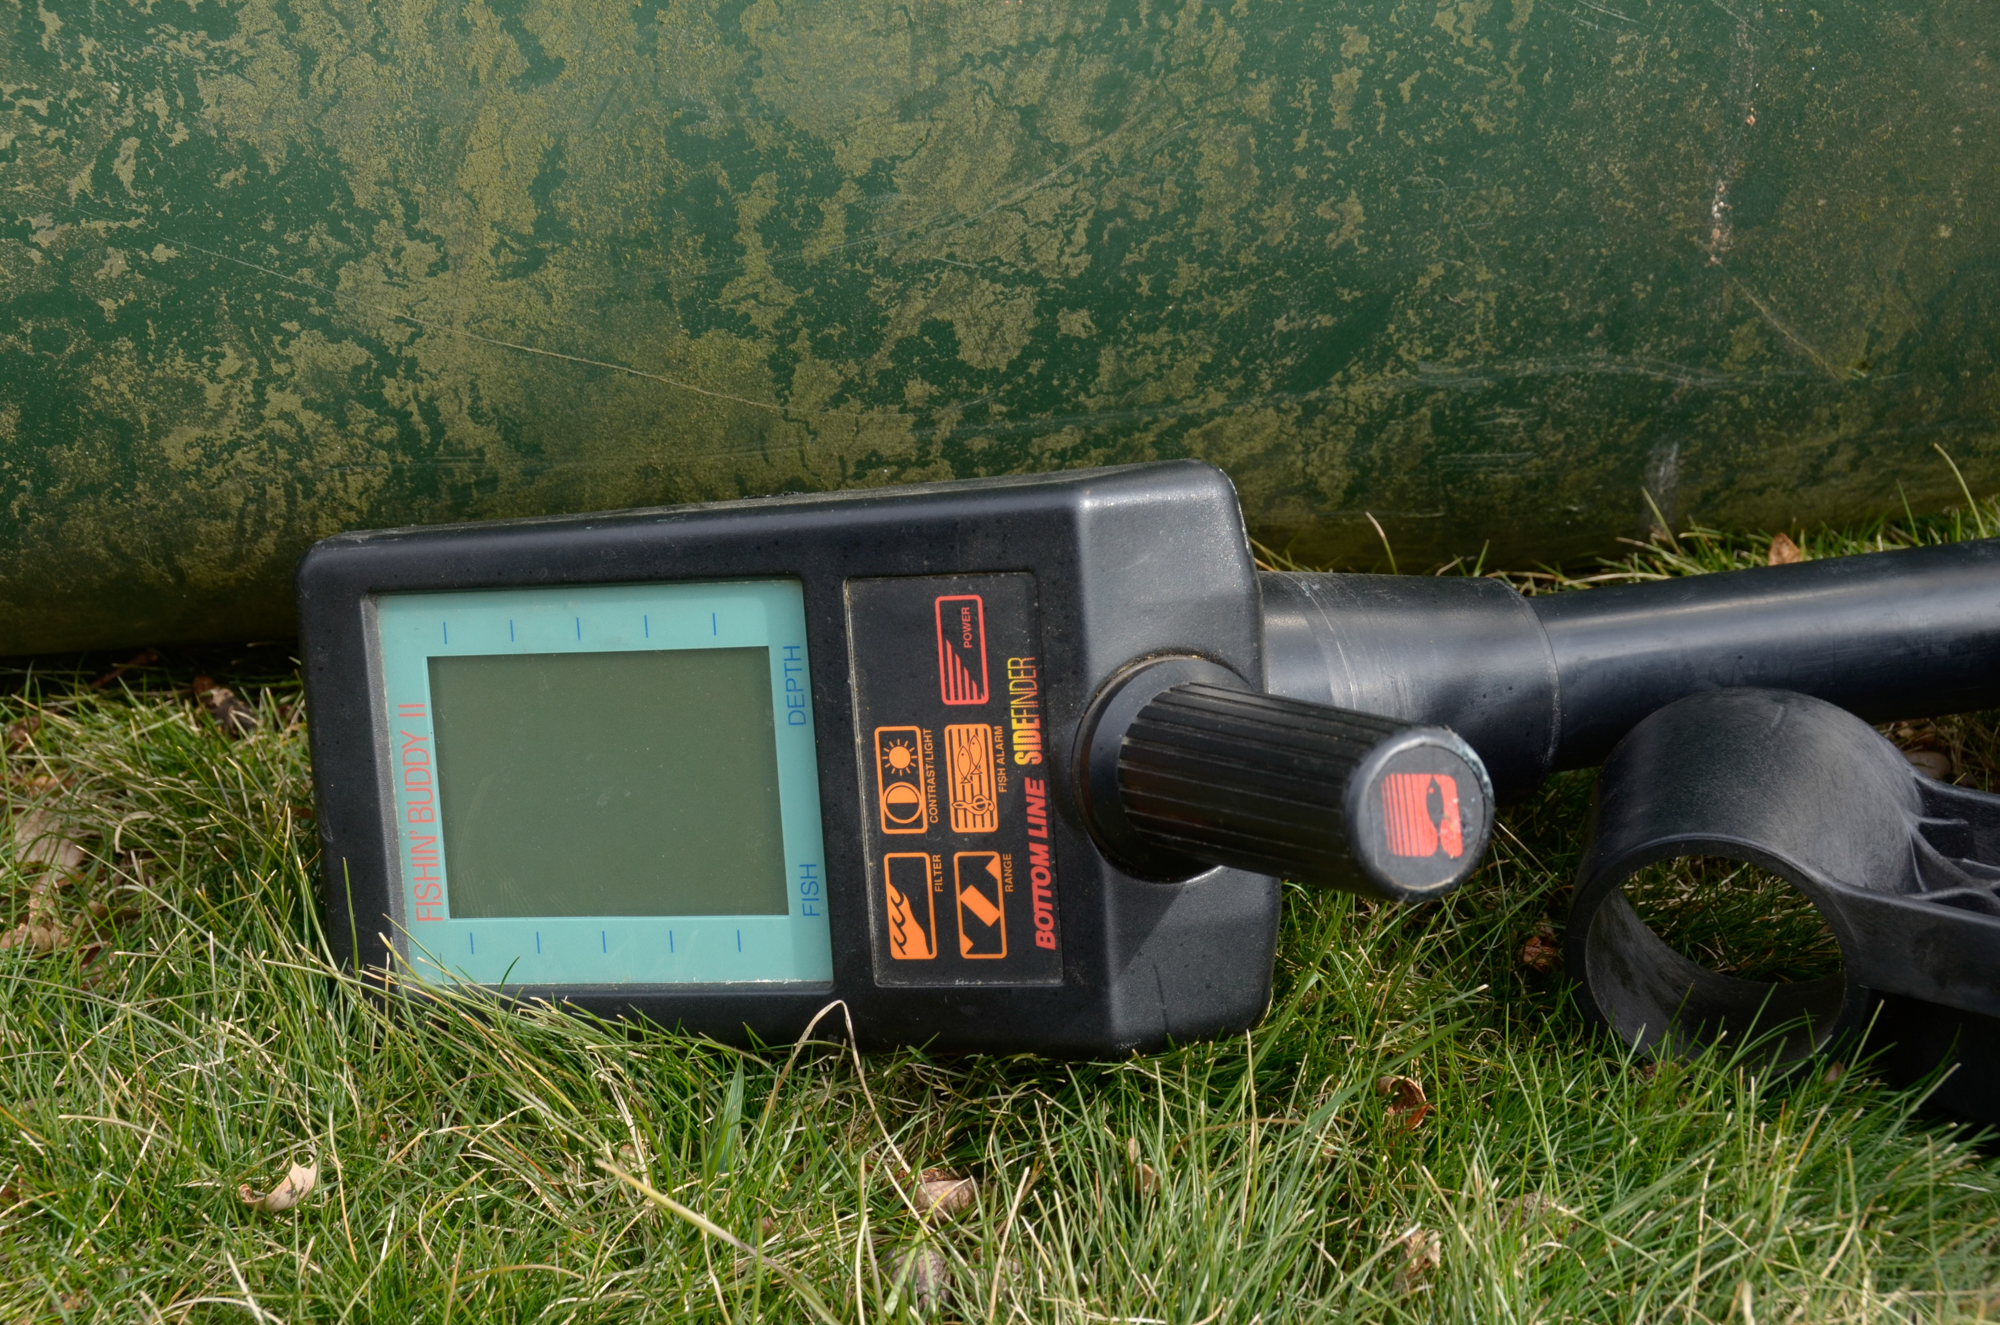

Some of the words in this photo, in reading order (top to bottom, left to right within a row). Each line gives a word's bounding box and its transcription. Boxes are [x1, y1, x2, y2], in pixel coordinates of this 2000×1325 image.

[960, 606, 973, 649] POWER
[397, 703, 427, 718] II
[783, 645, 807, 726] DEPTH
[1007, 656, 1043, 766] SIDEFINDER
[993, 725, 1006, 766] ALARM
[400, 729, 436, 824] BUDDY
[922, 728, 939, 824] CONTRAST/LIGHT
[997, 768, 1008, 793] FISH
[1024, 776, 1048, 838] LINE
[409, 829, 444, 922] FISHIN'
[799, 863, 821, 917] FISH
[932, 854, 944, 893] FILTER
[1002, 853, 1014, 893] RANGE
[1028, 842, 1056, 950] BOTTOM
